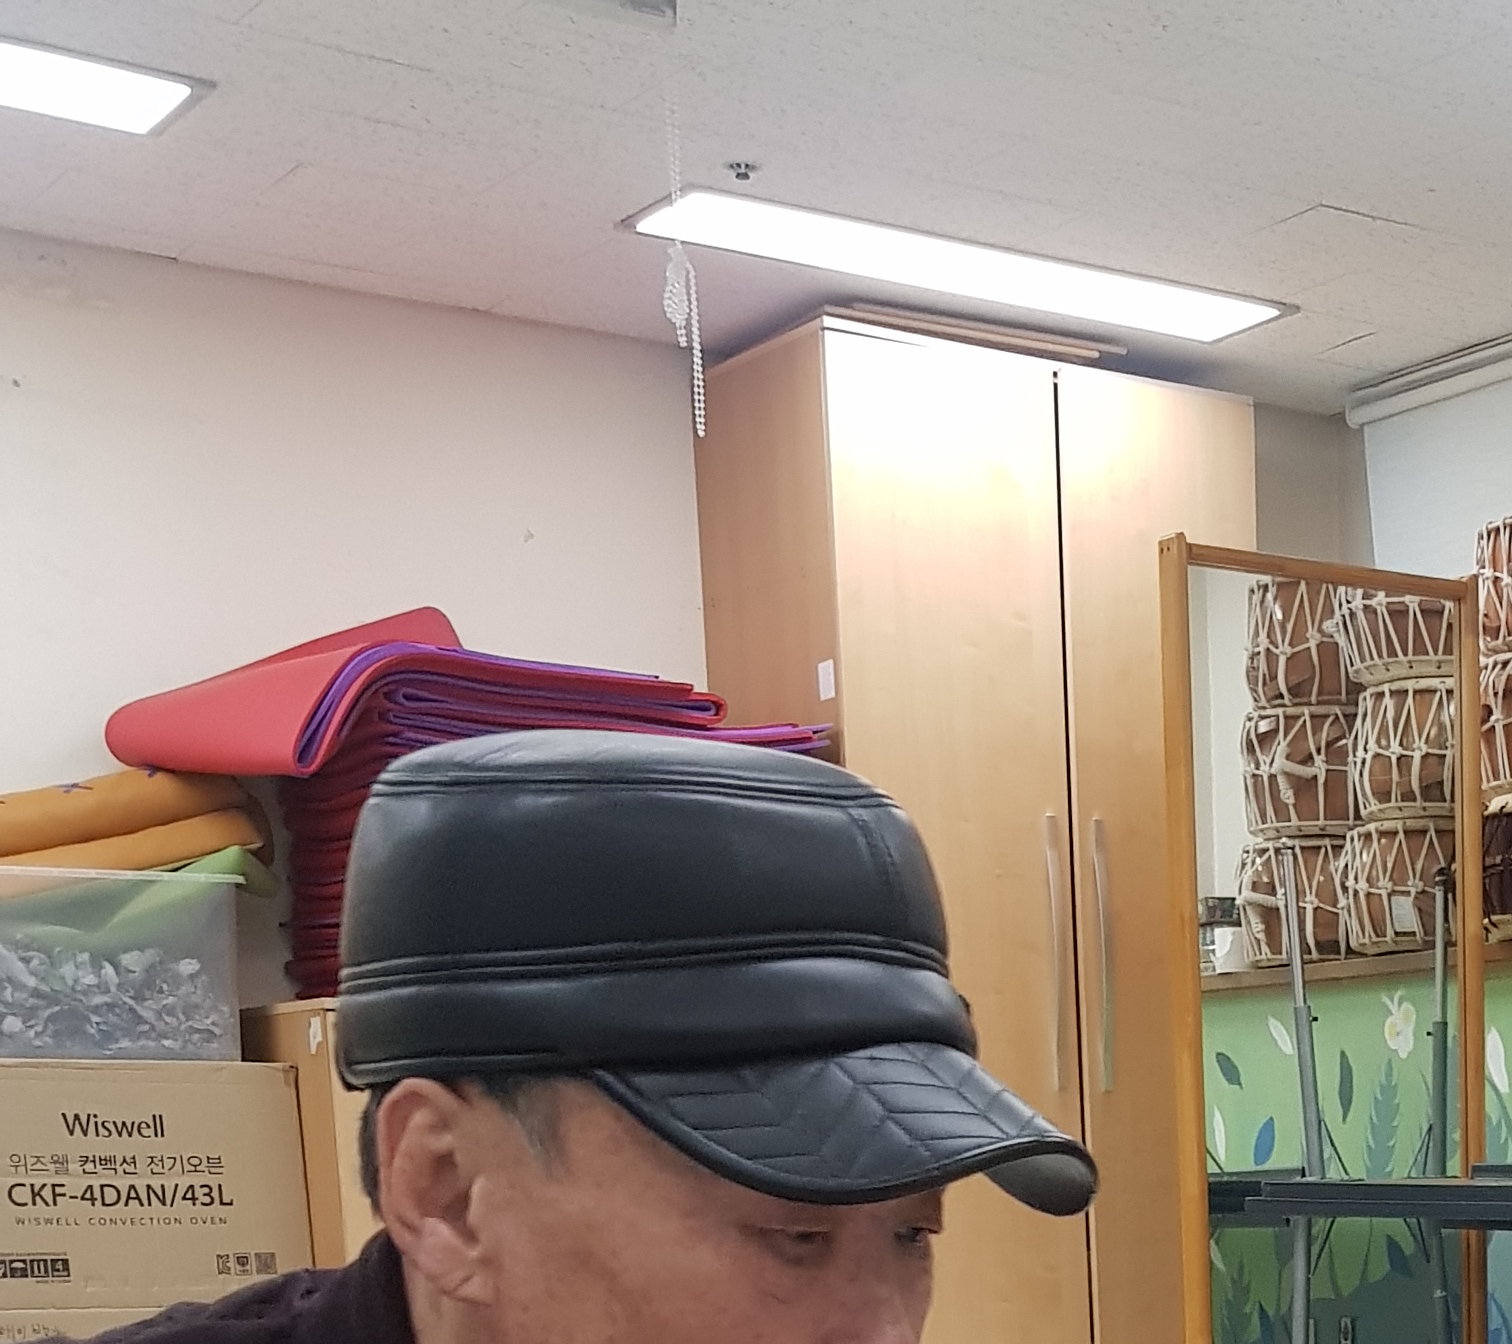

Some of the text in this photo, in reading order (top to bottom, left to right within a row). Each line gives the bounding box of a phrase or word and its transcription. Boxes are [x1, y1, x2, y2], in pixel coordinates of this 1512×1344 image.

[61, 1112, 165, 1139] Wiswell
[78, 1153, 138, 1175] 컨벡션
[146, 1154, 225, 1176] 전기오븐
[7, 1182, 234, 1208] CKF-4DAN/43L
[14, 1215, 227, 1226] WISWELL CONVECTION OVEN
